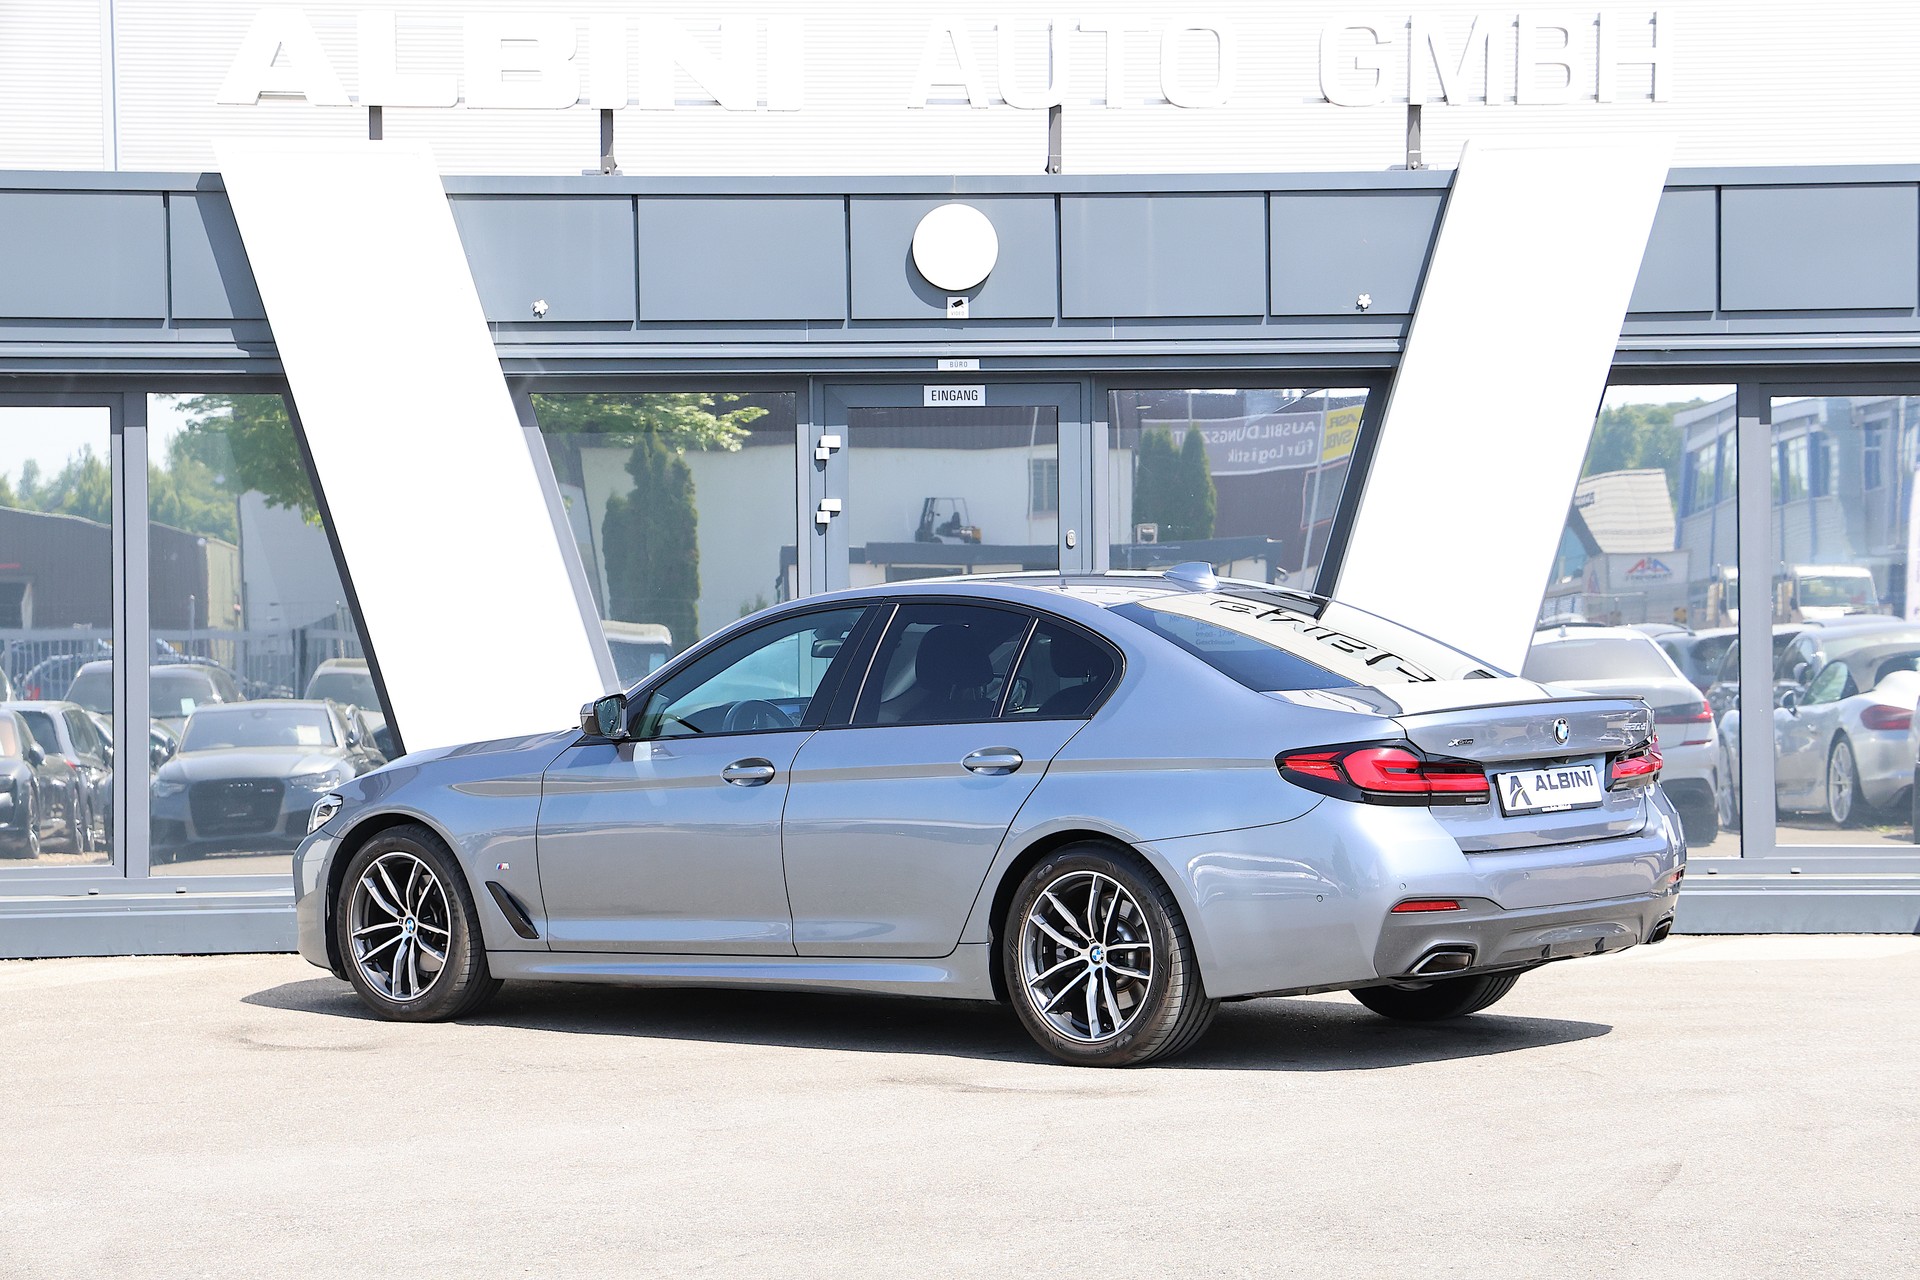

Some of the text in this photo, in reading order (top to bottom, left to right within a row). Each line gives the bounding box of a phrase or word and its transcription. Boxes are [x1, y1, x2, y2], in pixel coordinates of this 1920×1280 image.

[216, 8, 1675, 112] ALBINI AUTO GMBH
[949, 360, 968, 368] BÜRO
[931, 389, 979, 402] EINGANG
[1535, 770, 1594, 792] ALBINI
